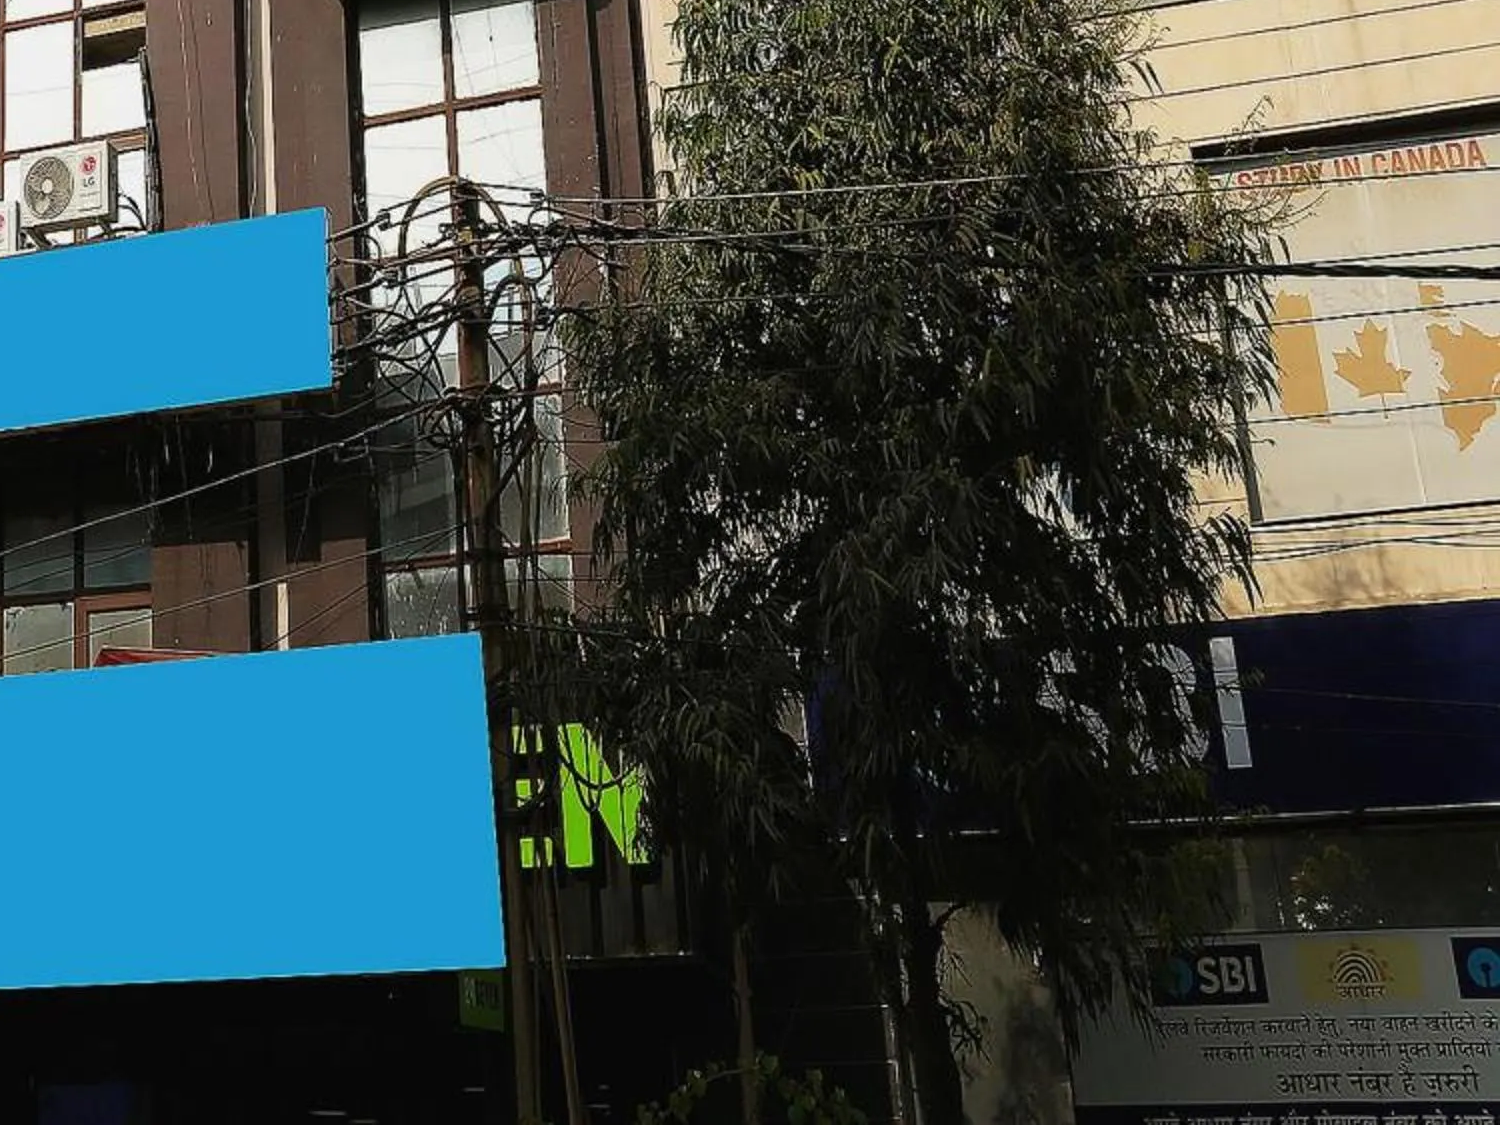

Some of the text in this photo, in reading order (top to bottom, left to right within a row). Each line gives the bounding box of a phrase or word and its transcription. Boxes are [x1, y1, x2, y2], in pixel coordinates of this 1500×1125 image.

[1333, 156, 1363, 186] IN
[1372, 139, 1487, 177] CANADA
[1197, 956, 1257, 994] SBI
[1276, 1072, 1343, 1096] आधार
